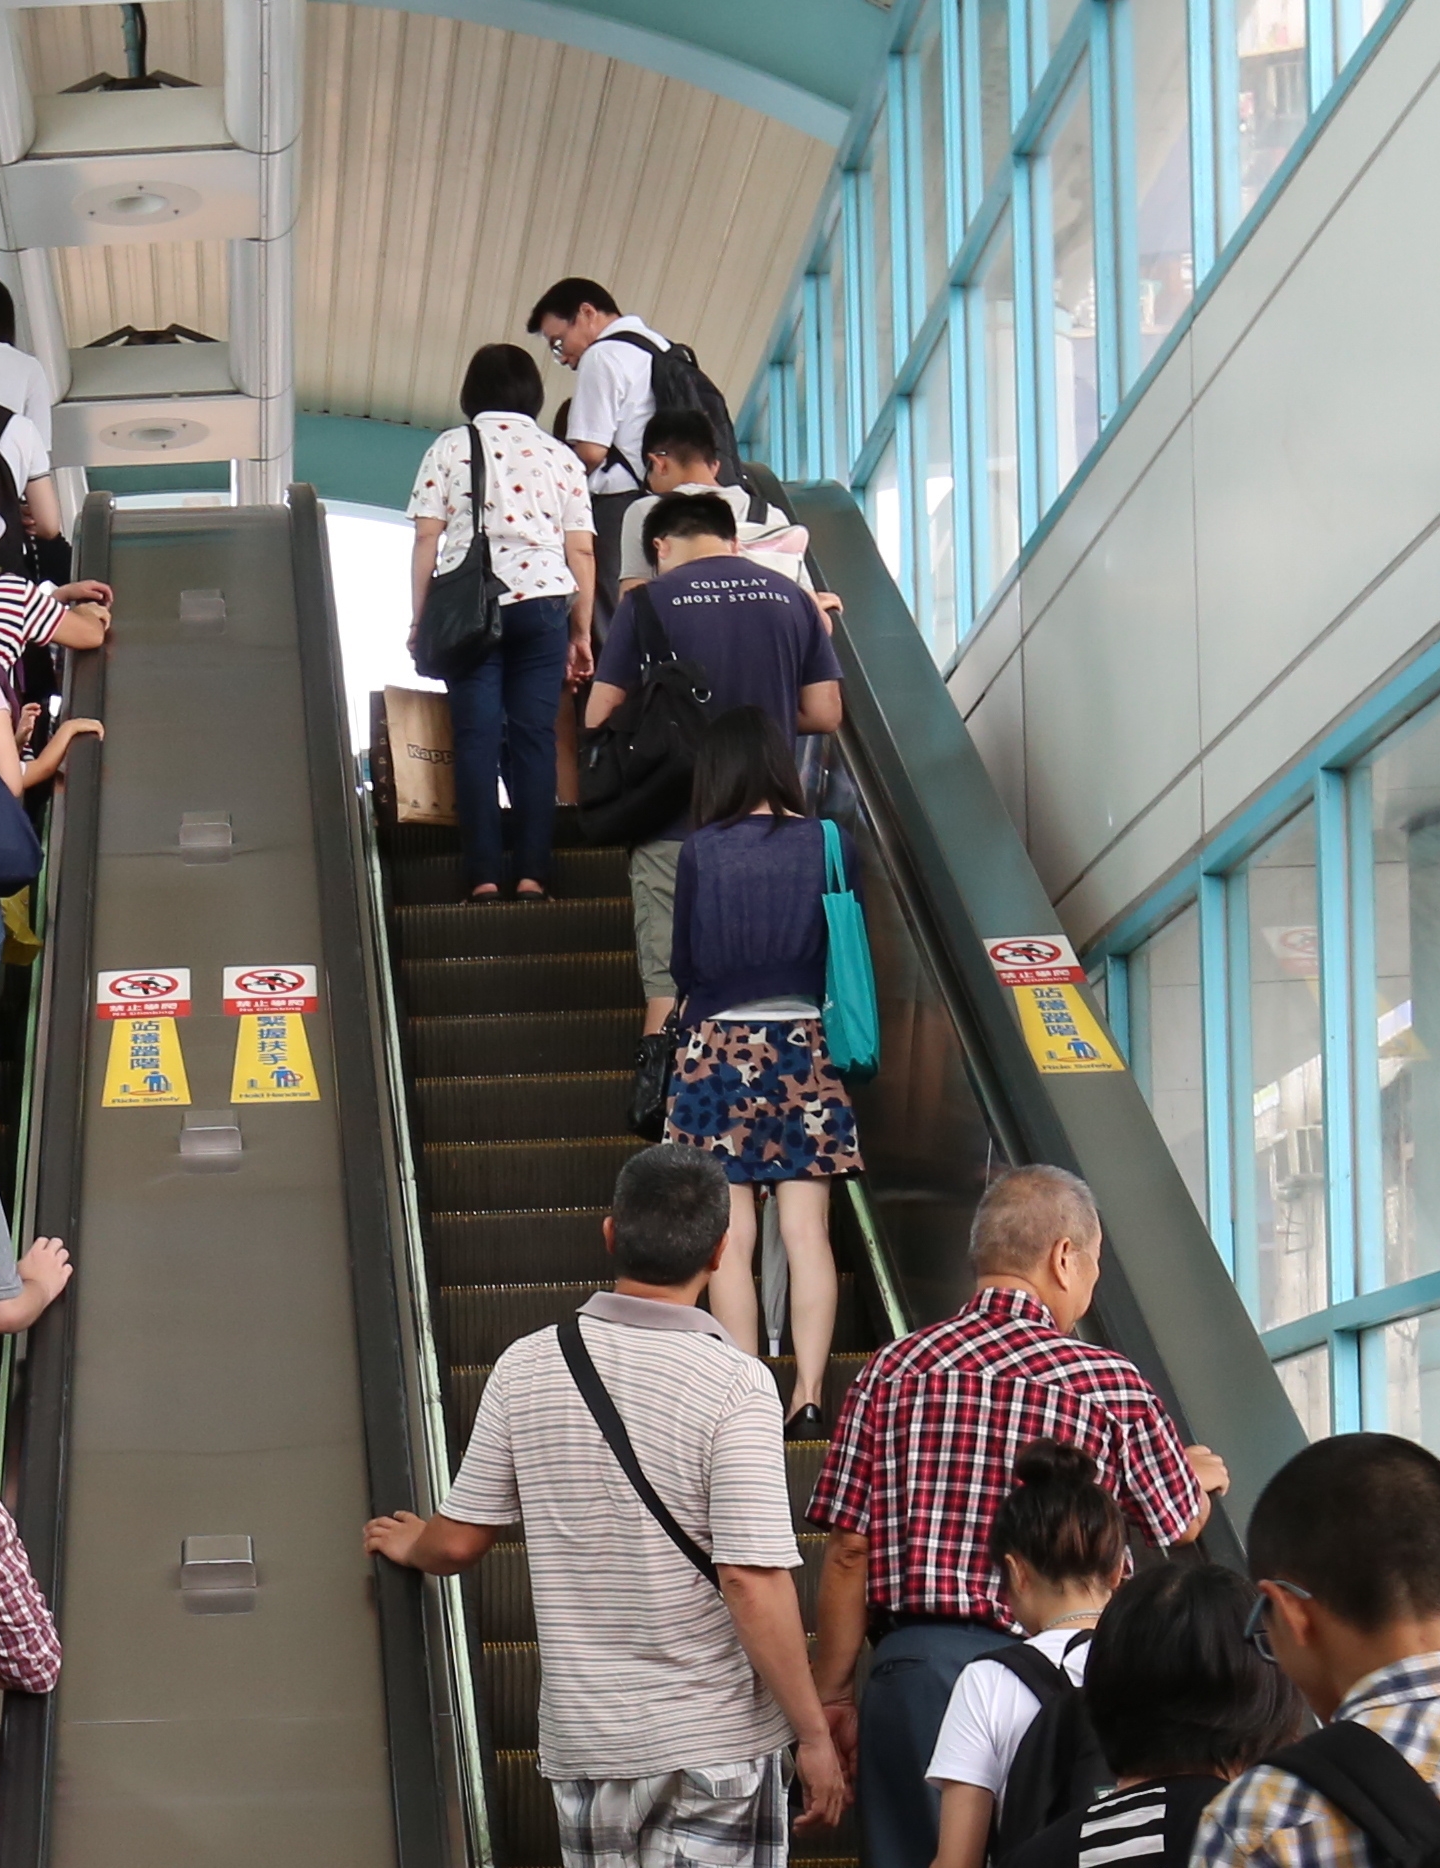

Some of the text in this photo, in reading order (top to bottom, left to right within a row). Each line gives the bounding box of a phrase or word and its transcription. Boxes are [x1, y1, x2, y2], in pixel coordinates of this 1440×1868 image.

[691, 578, 768, 590] COLDPLAY
[672, 592, 790, 605] GHOST STORIES
[407, 744, 454, 764] Kapp
